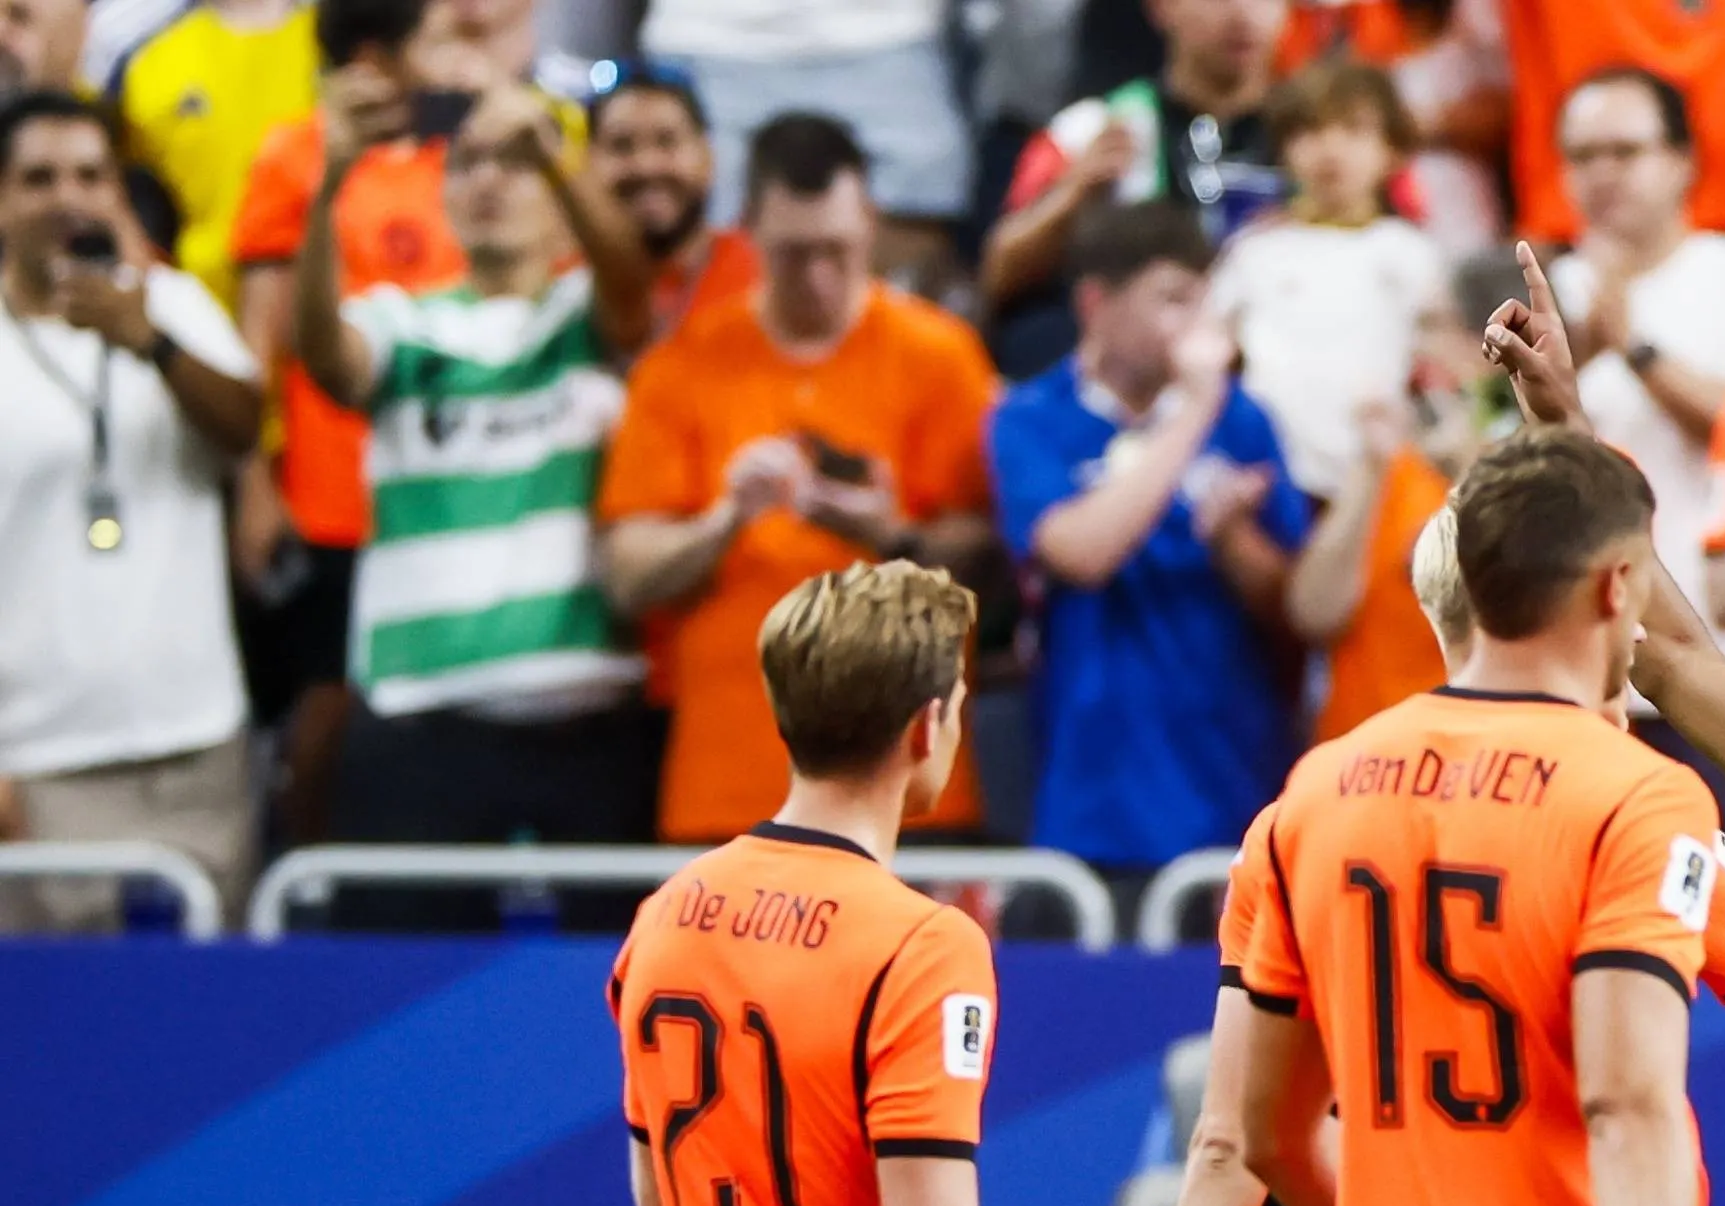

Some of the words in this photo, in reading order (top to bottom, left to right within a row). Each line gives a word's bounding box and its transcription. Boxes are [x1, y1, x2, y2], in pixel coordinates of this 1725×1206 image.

[677, 876, 726, 931] De
[732, 888, 839, 949] JONG
[1345, 859, 1531, 1132] 15
